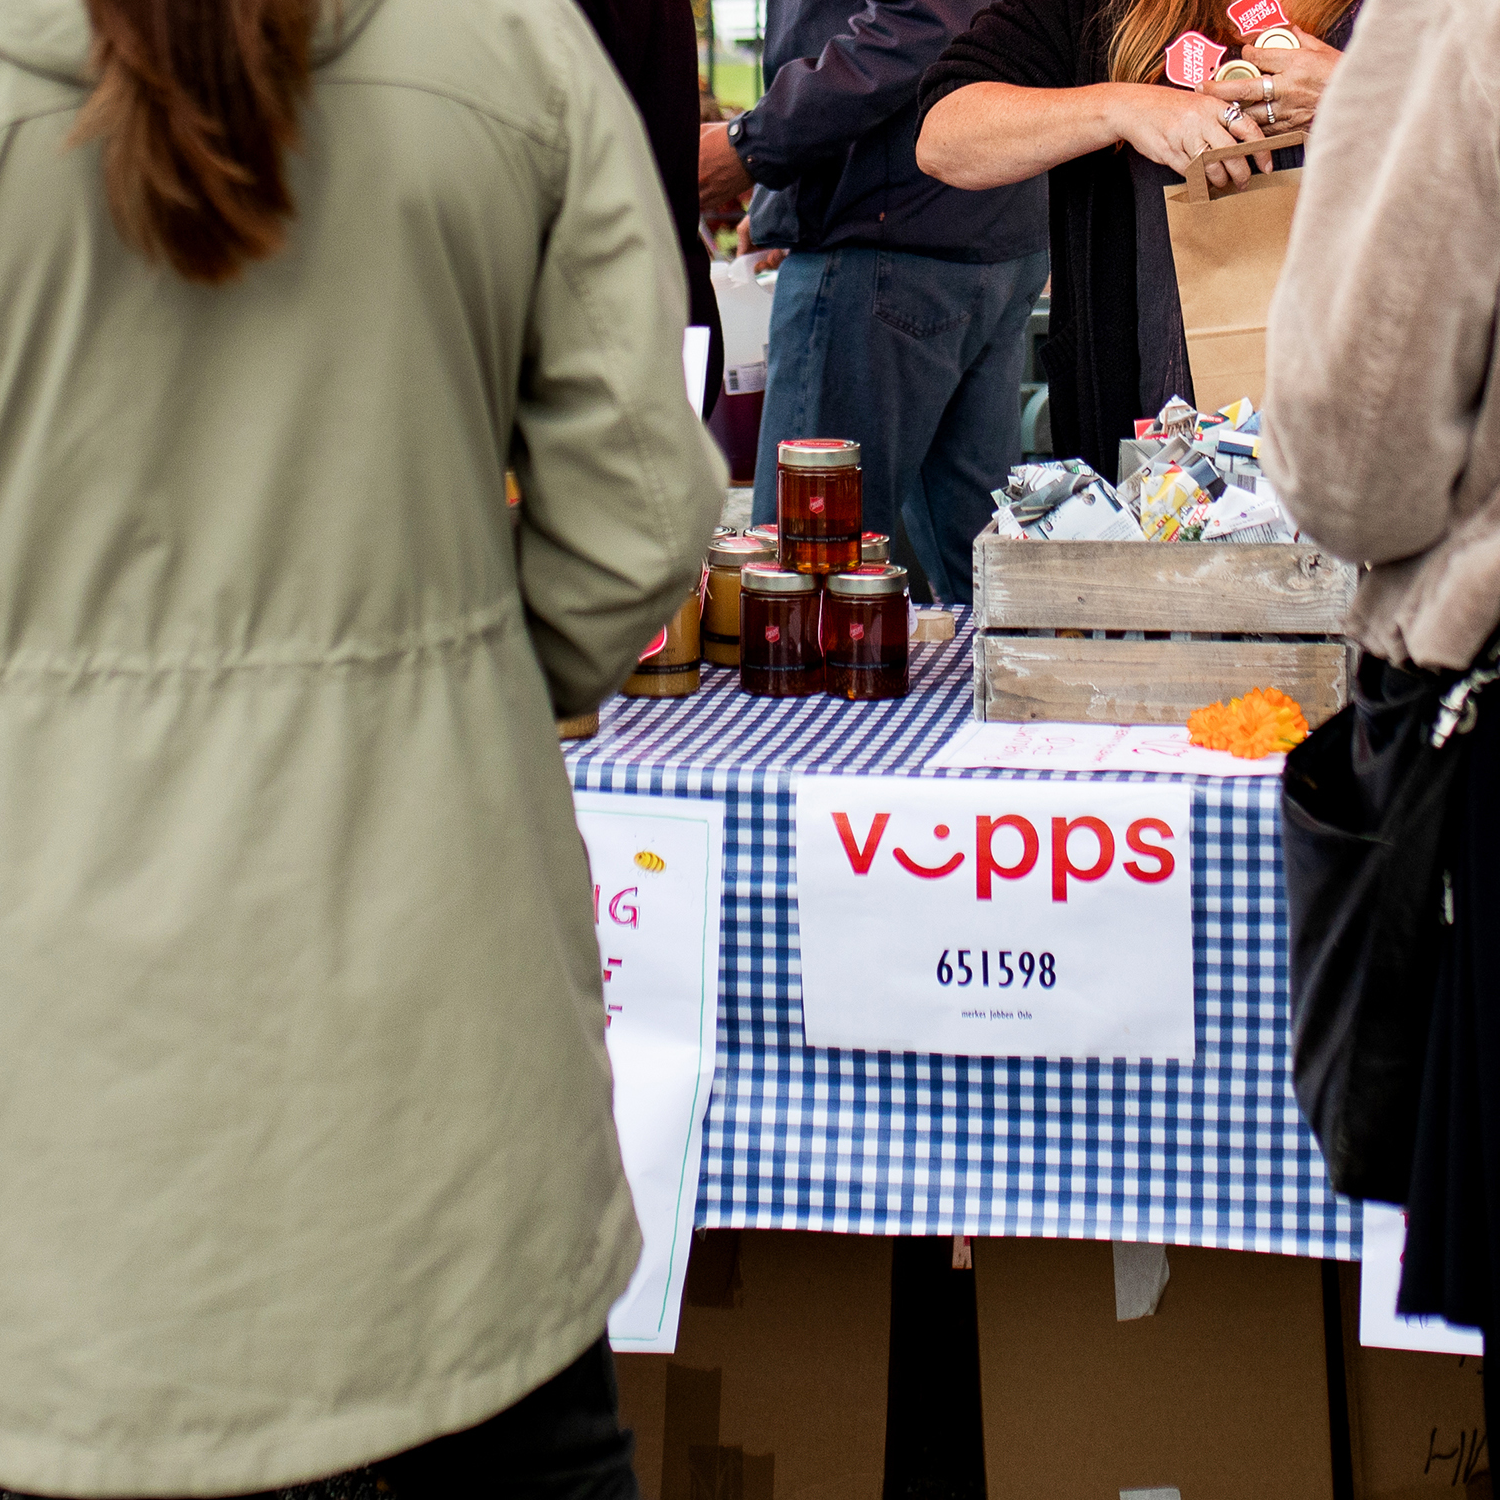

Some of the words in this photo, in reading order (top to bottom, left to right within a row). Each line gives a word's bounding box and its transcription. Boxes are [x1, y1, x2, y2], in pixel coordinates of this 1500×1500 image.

[1182, 39, 1193, 83] ARMEEN
[935, 948, 1057, 991] 651598
[1017, 1010, 1033, 1020] Oslo
